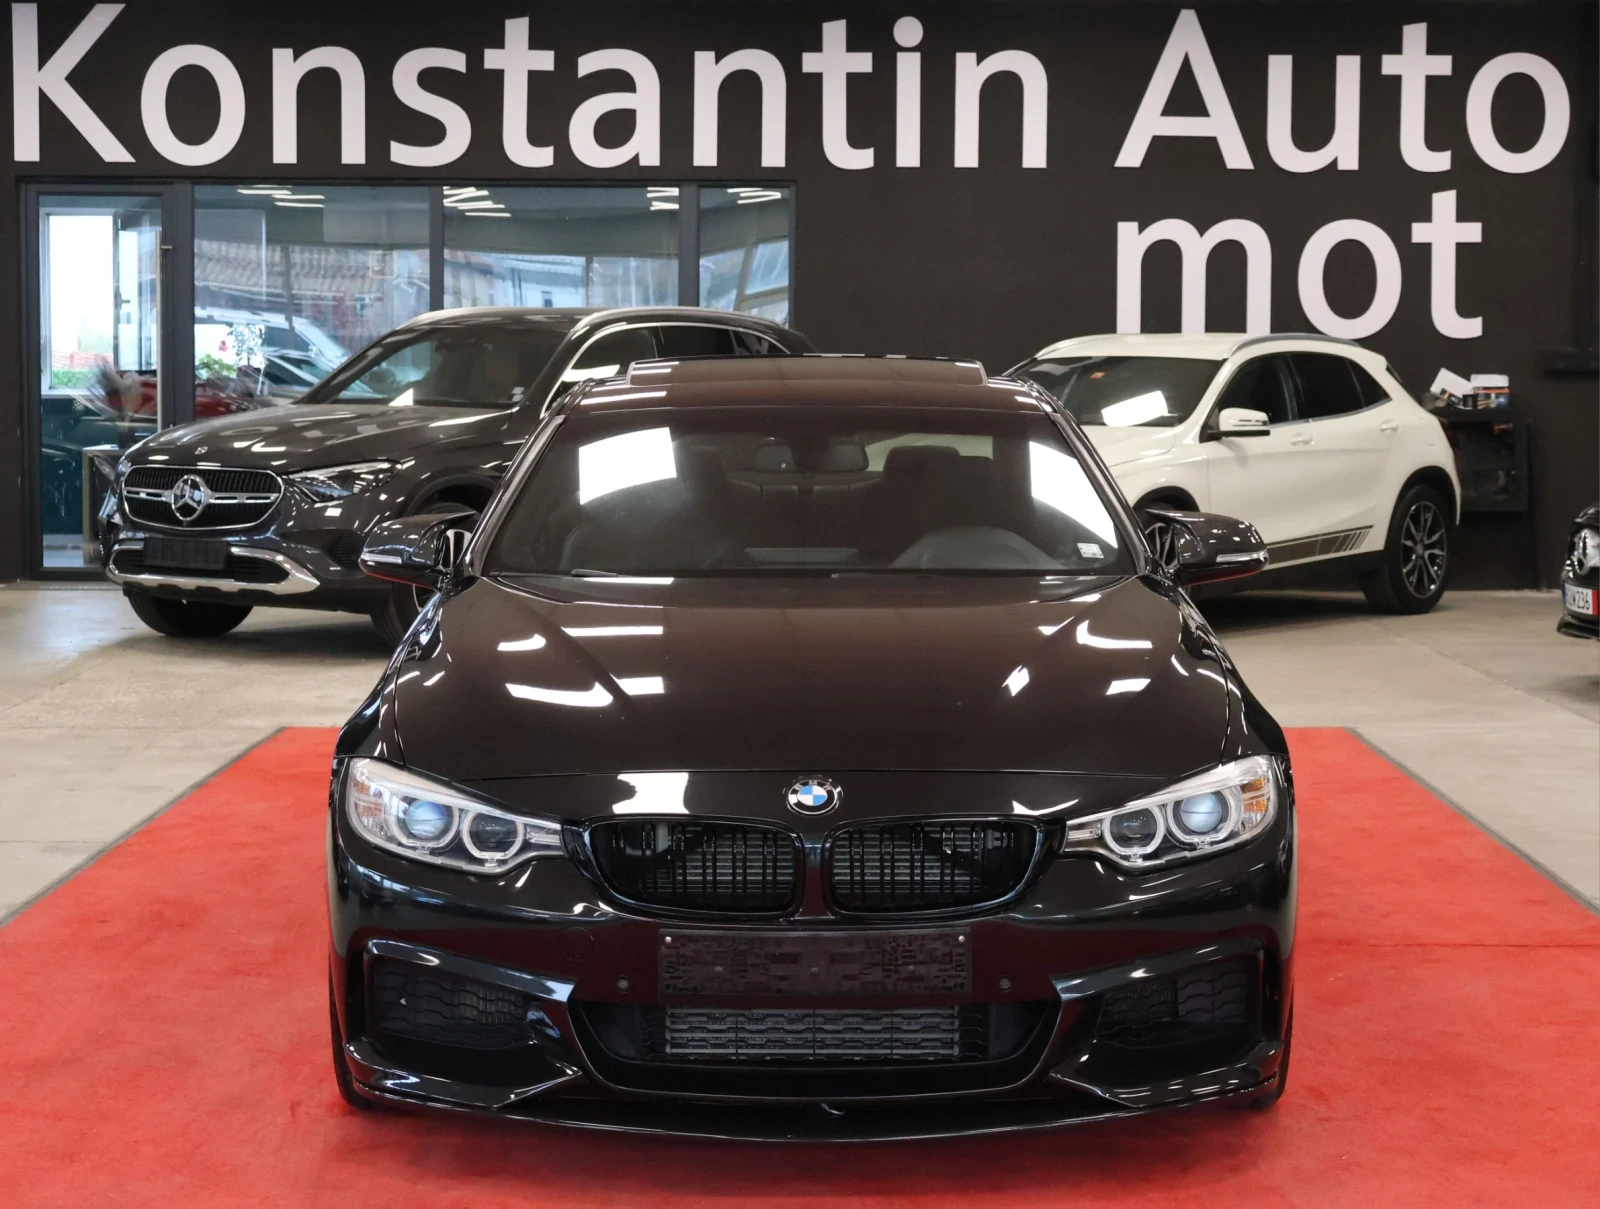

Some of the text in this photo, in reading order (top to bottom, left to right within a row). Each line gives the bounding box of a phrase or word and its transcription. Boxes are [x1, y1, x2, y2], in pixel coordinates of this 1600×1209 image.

[11, 3, 1571, 174] Konstantin Auto
[1116, 189, 1483, 339] mot
